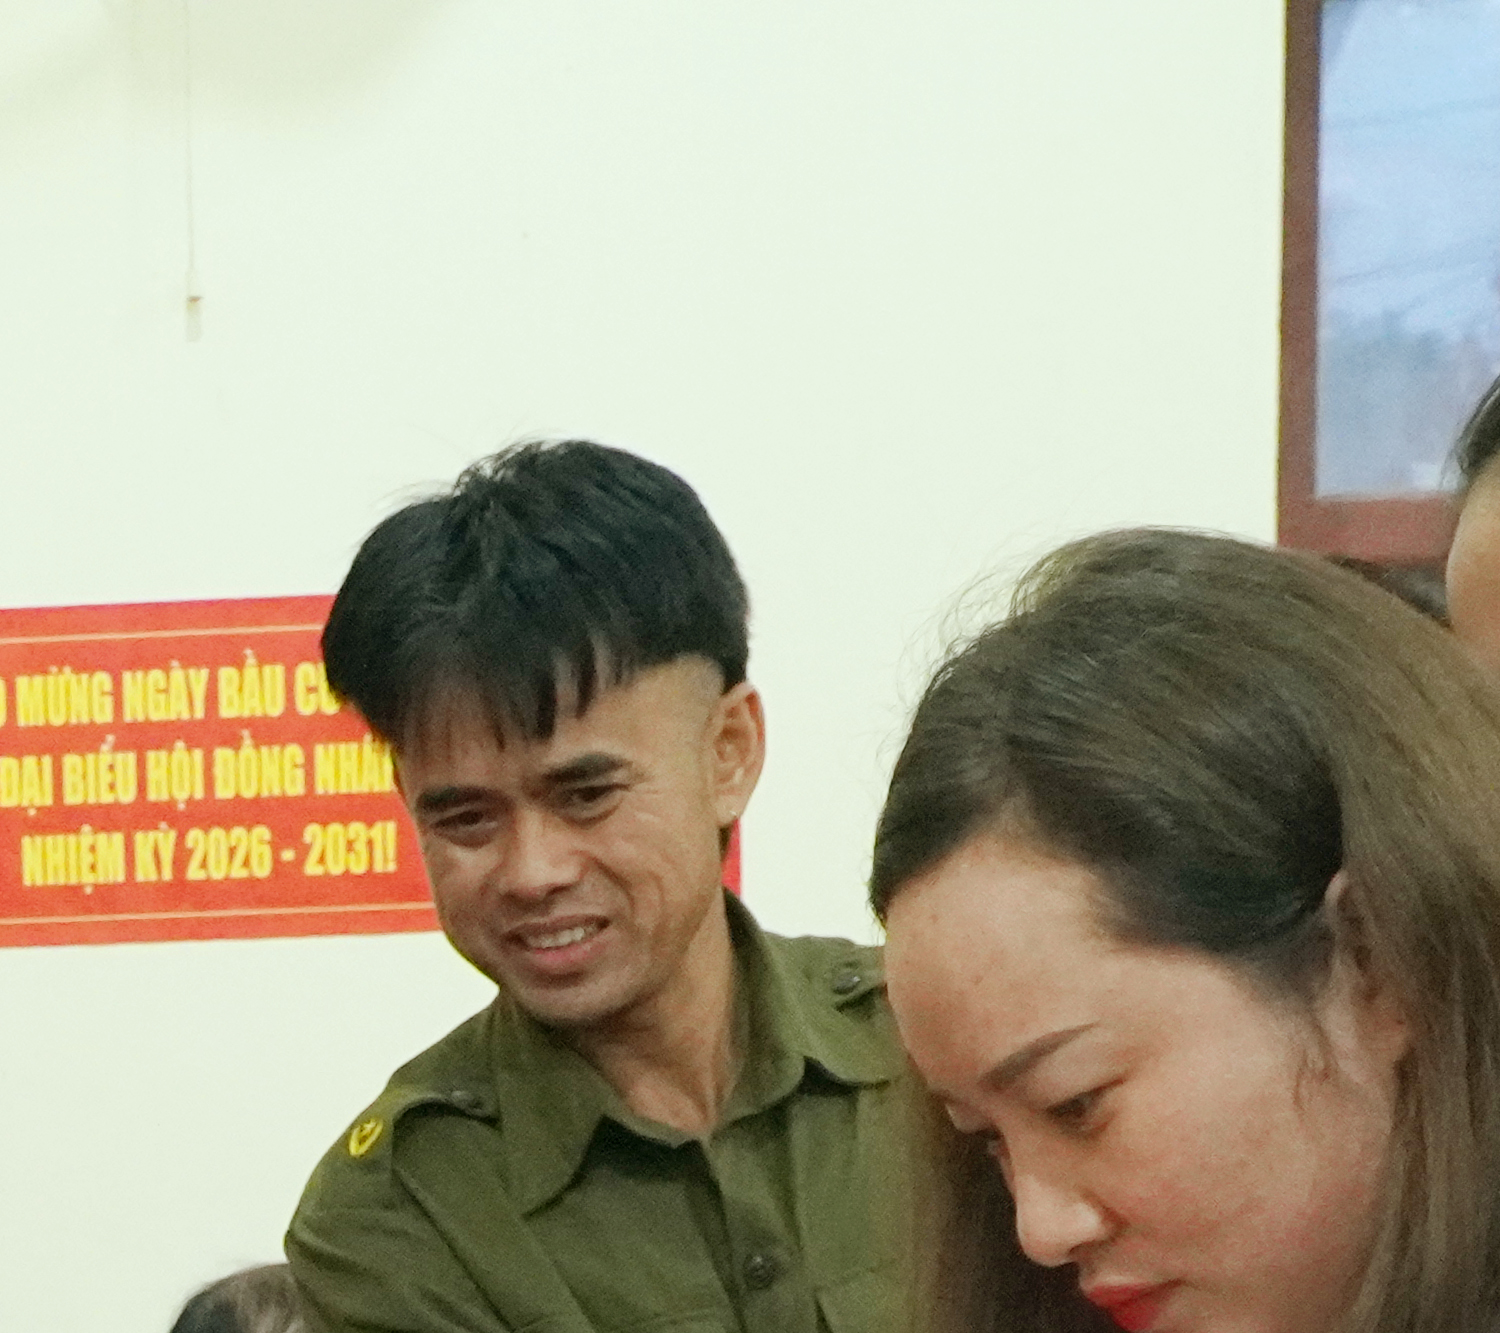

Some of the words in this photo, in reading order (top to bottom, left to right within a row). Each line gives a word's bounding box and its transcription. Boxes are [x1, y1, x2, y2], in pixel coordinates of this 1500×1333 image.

[15, 665, 114, 727] MỪNG
[122, 659, 209, 723] NGÀY
[217, 648, 286, 719] BẦU
[61, 734, 137, 806] BIỂU
[145, 739, 205, 810] HỘI
[212, 729, 305, 800] ĐỒNG
[21, 824, 125, 894] NHIỆM
[134, 822, 177, 882] KỲ
[185, 825, 272, 880] 2026
[303, 821, 397, 876] 2031!
